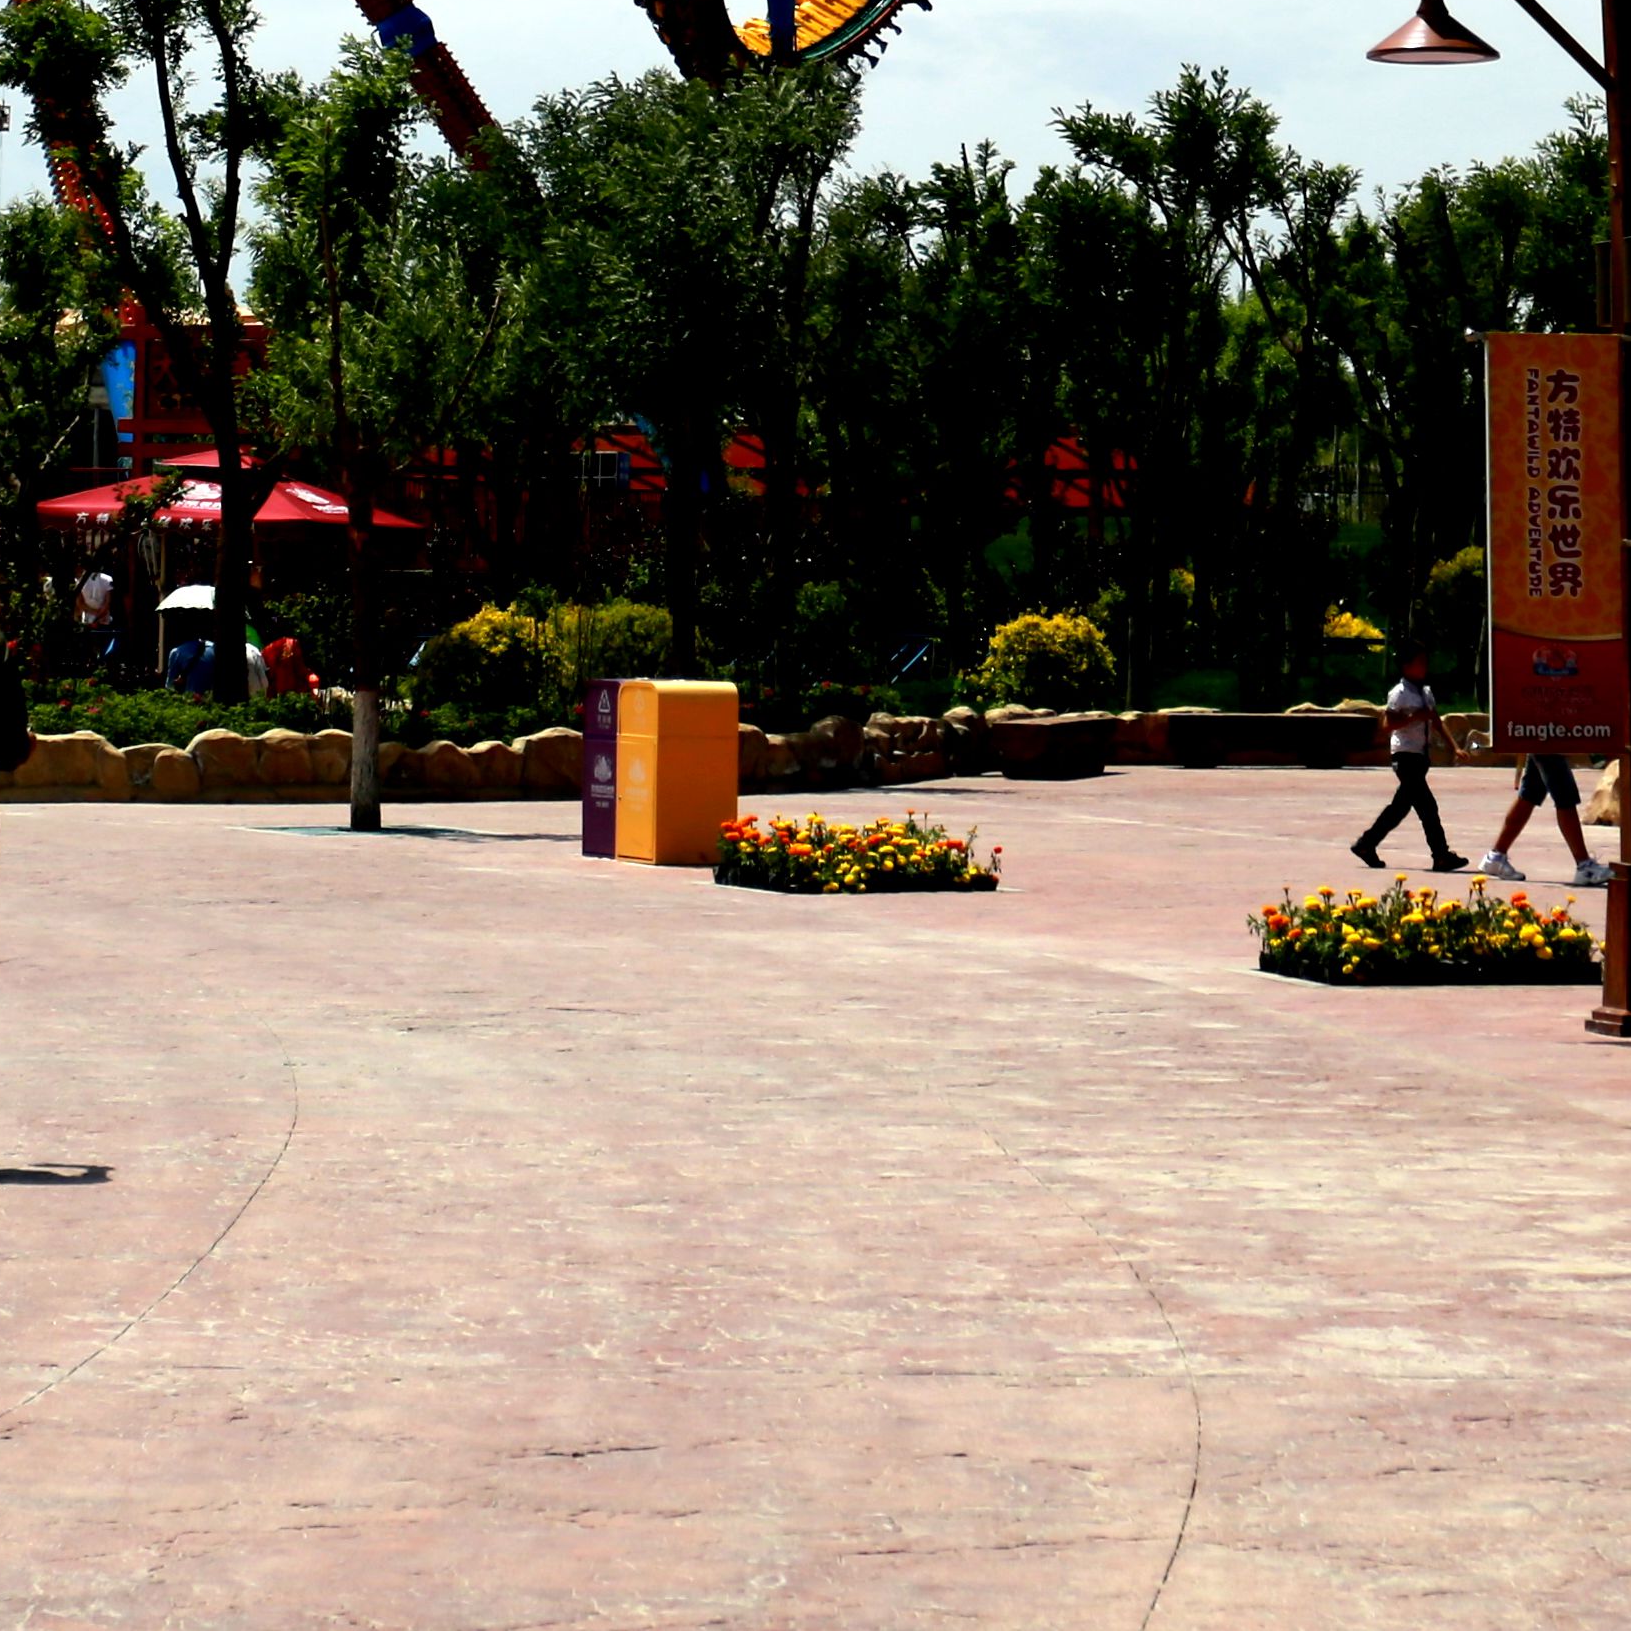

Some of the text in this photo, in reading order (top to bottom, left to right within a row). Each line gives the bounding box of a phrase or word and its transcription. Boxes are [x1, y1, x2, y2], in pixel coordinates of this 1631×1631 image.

[1526, 367, 1542, 597] FANTAWILD ADVENTURE
[1545, 369, 1583, 597] 方特欢乐世界
[1507, 720, 1612, 742] fangte.com
